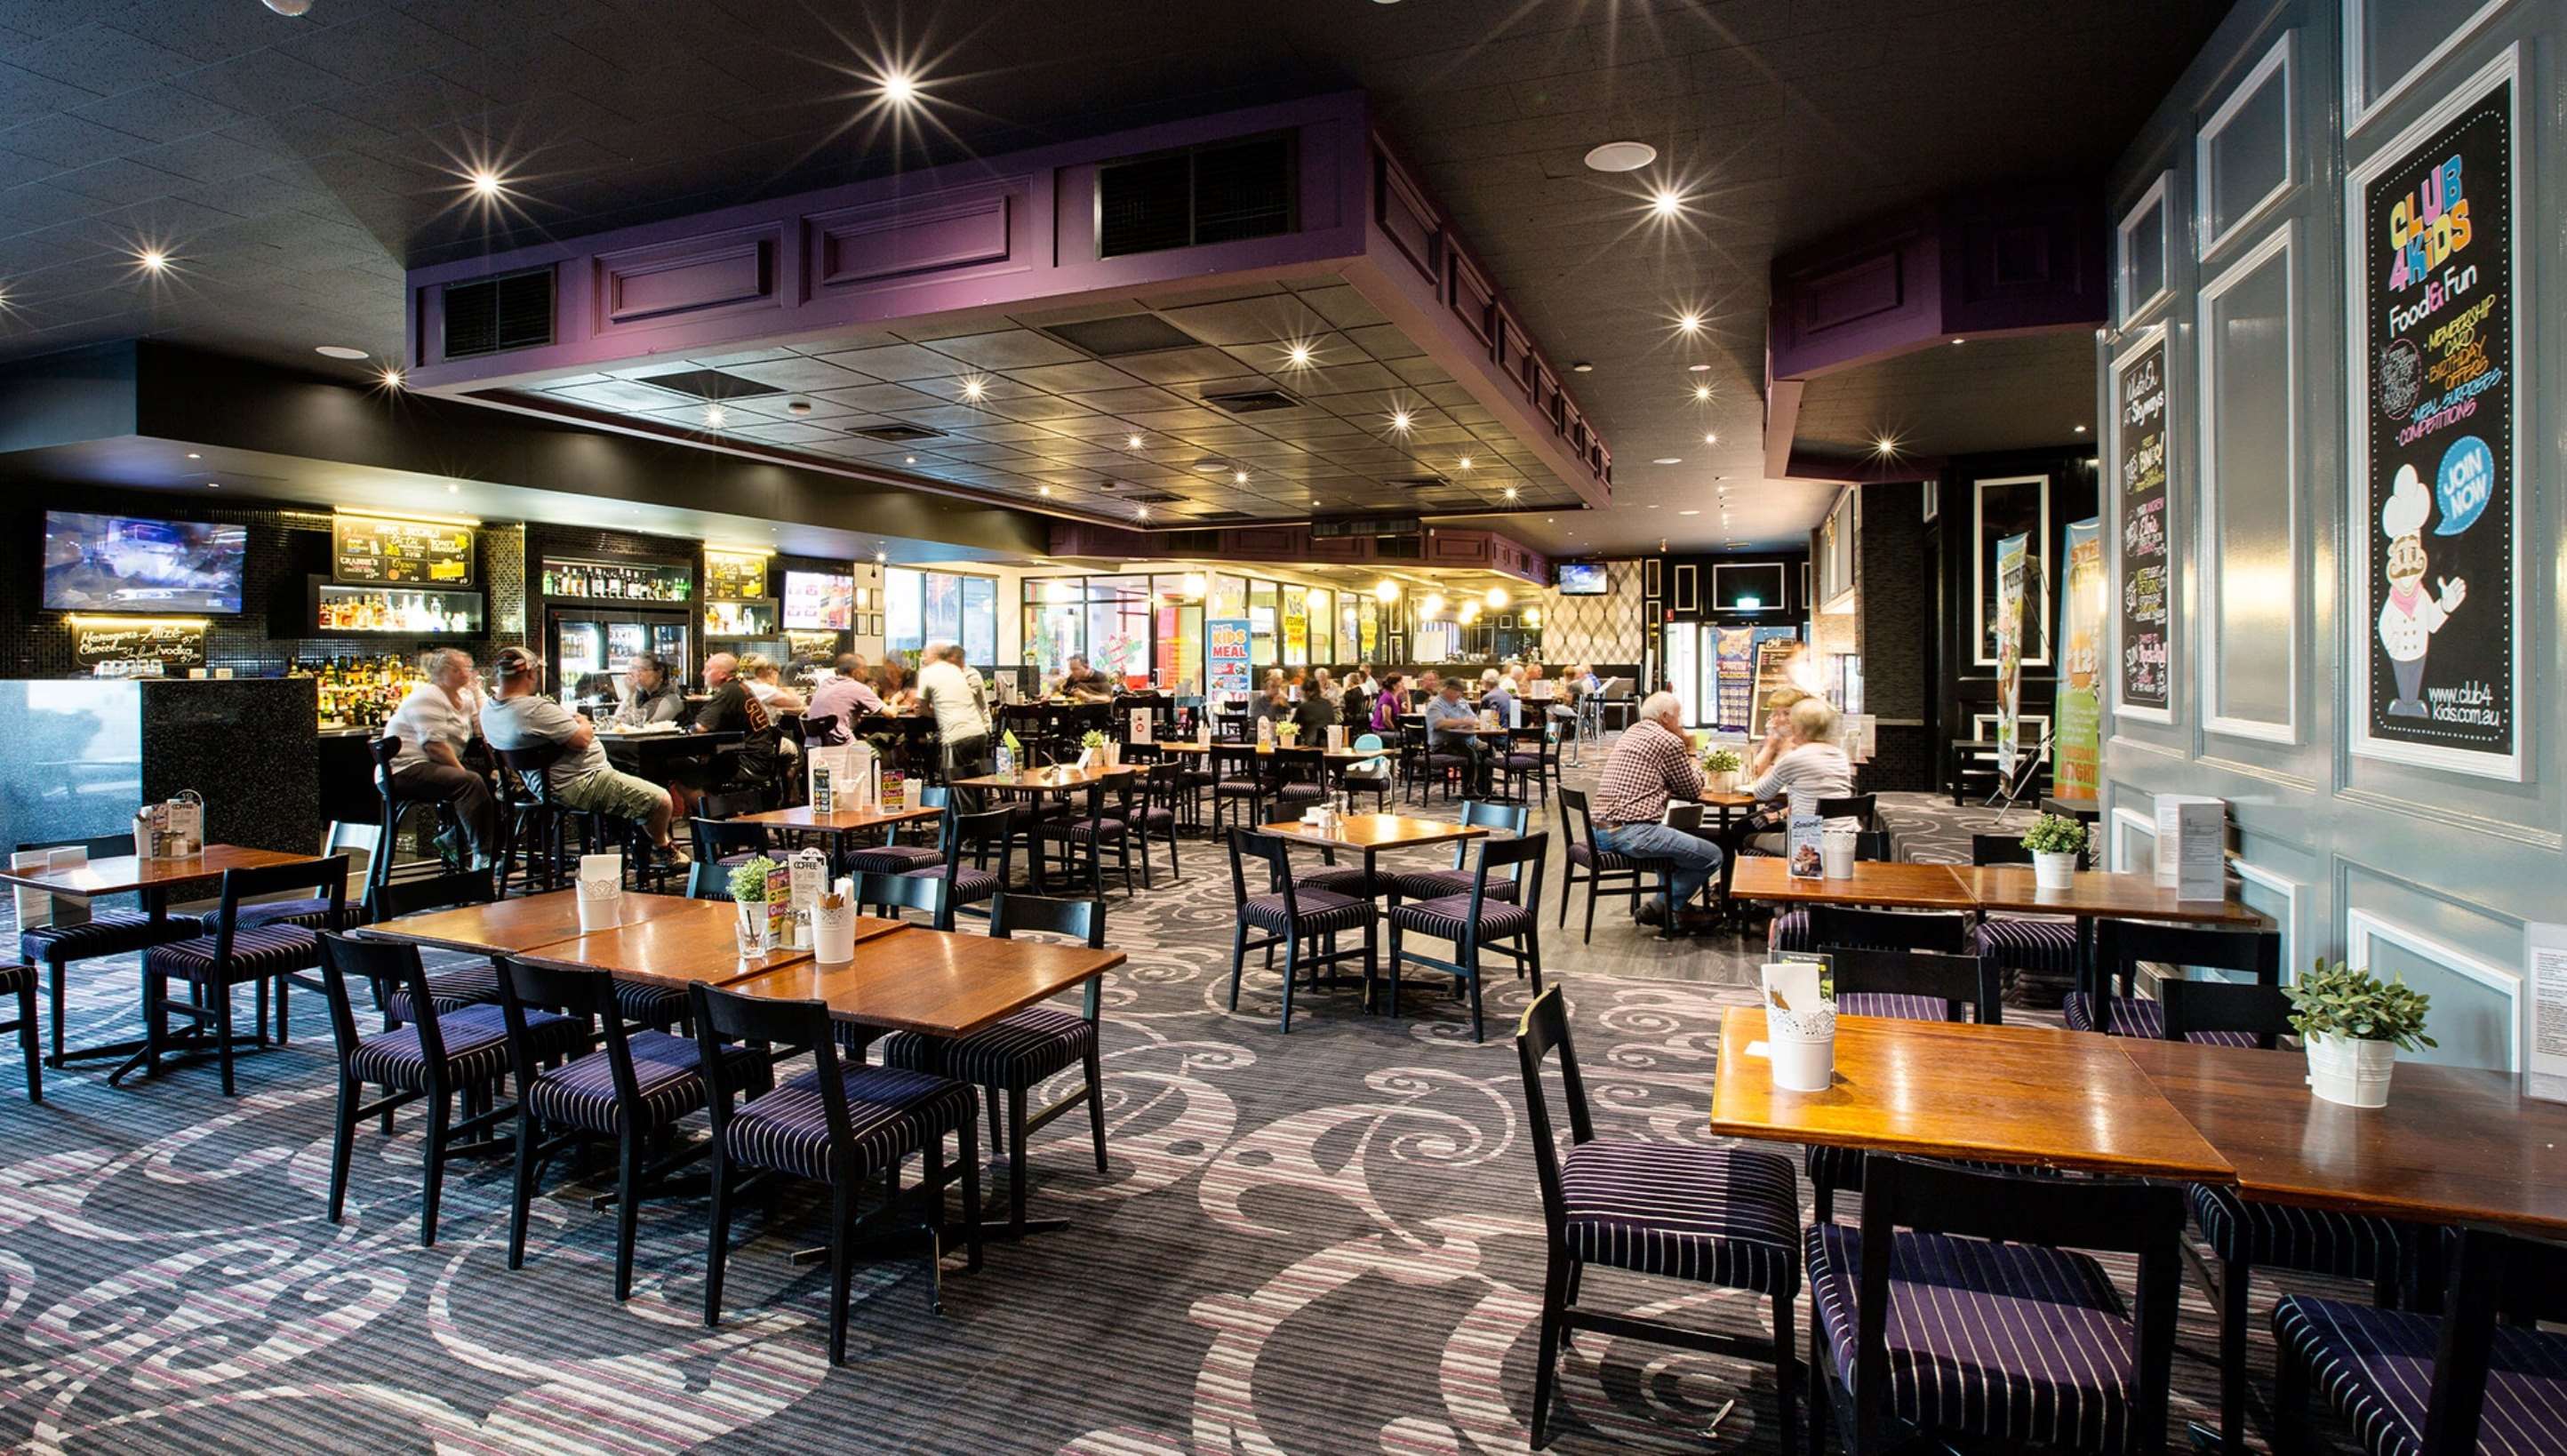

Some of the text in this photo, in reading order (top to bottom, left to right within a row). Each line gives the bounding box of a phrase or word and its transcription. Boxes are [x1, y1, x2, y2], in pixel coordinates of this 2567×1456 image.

[2390, 154, 2462, 251] CLUB
[2429, 335, 2487, 383] BIRTHDAY
[2445, 356, 2489, 390] OFFERS
[2442, 367, 2502, 410] SURPRISES
[2399, 397, 2477, 446] COMPETITIONS
[2443, 447, 2483, 496] JOIN
[2451, 473, 2486, 519] NOW
[1212, 629, 1247, 644] KIDS
[1212, 646, 1247, 658] MEAL
[2432, 700, 2500, 727] kids.com.au
[2060, 759, 2096, 784] NIGHT
[794, 860, 818, 870] COFFEE
